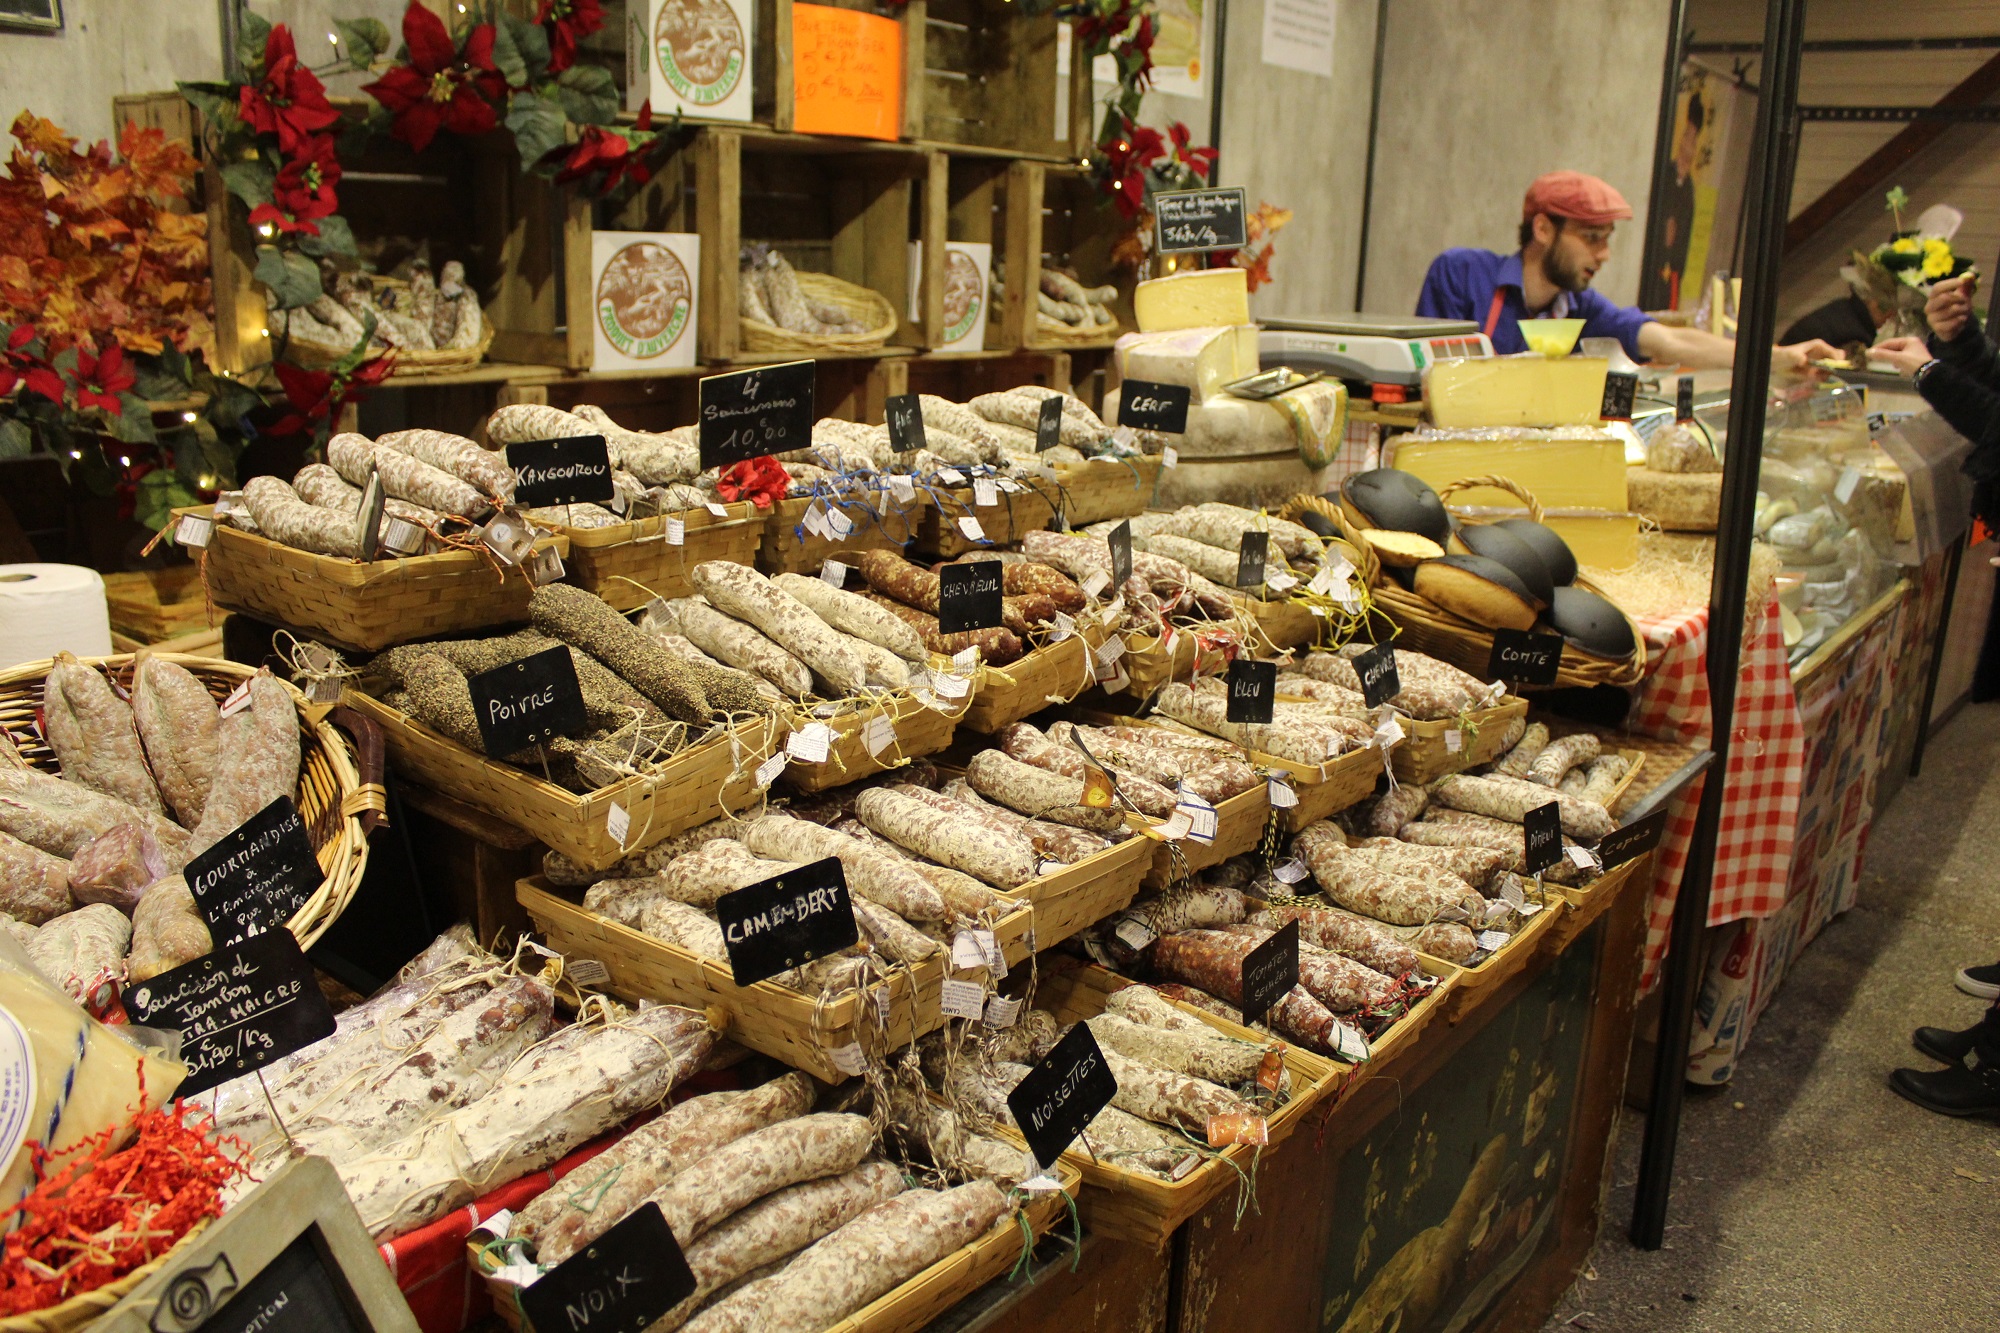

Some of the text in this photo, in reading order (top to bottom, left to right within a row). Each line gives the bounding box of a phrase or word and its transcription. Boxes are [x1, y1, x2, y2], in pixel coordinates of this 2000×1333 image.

[601, 306, 687, 355] PRODUIT D'AUVERGNE
[743, 376, 760, 400] 4
[1131, 396, 1173, 412] CERF
[515, 463, 605, 487] KANGOUROU
[1234, 678, 1261, 697] BLEU
[194, 813, 300, 896] GOURMANDISE
[727, 886, 839, 944] CAMEMBERT
[176, 984, 252, 1023] Jambon
